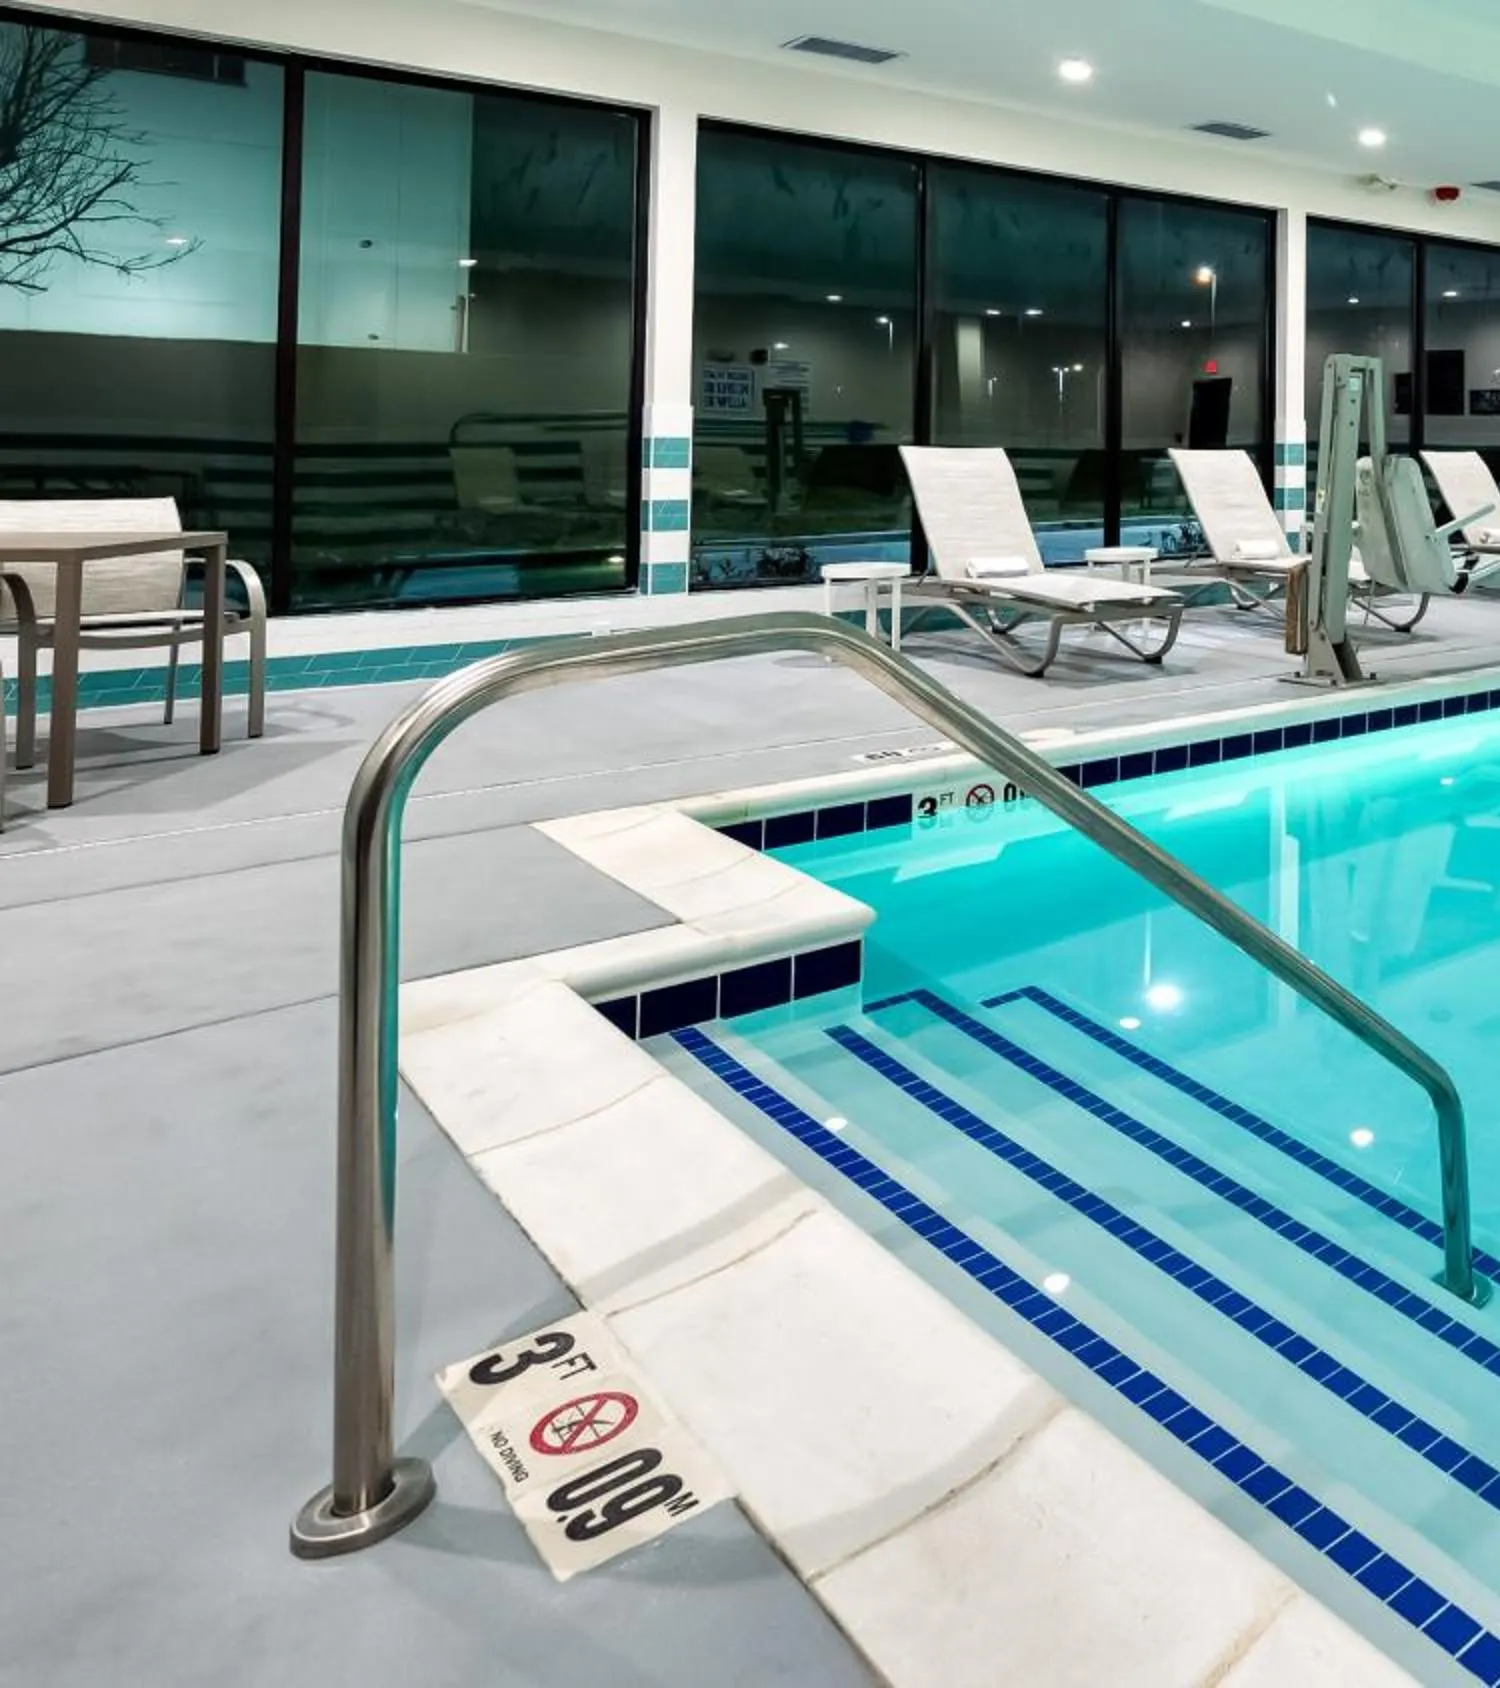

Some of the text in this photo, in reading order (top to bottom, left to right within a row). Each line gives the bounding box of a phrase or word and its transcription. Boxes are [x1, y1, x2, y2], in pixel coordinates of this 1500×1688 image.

[939, 791, 955, 806] FT
[469, 1332, 597, 1385] 3 FT
[491, 1430, 529, 1483] NO DIVING
[547, 1448, 699, 1541] 0.9 M
